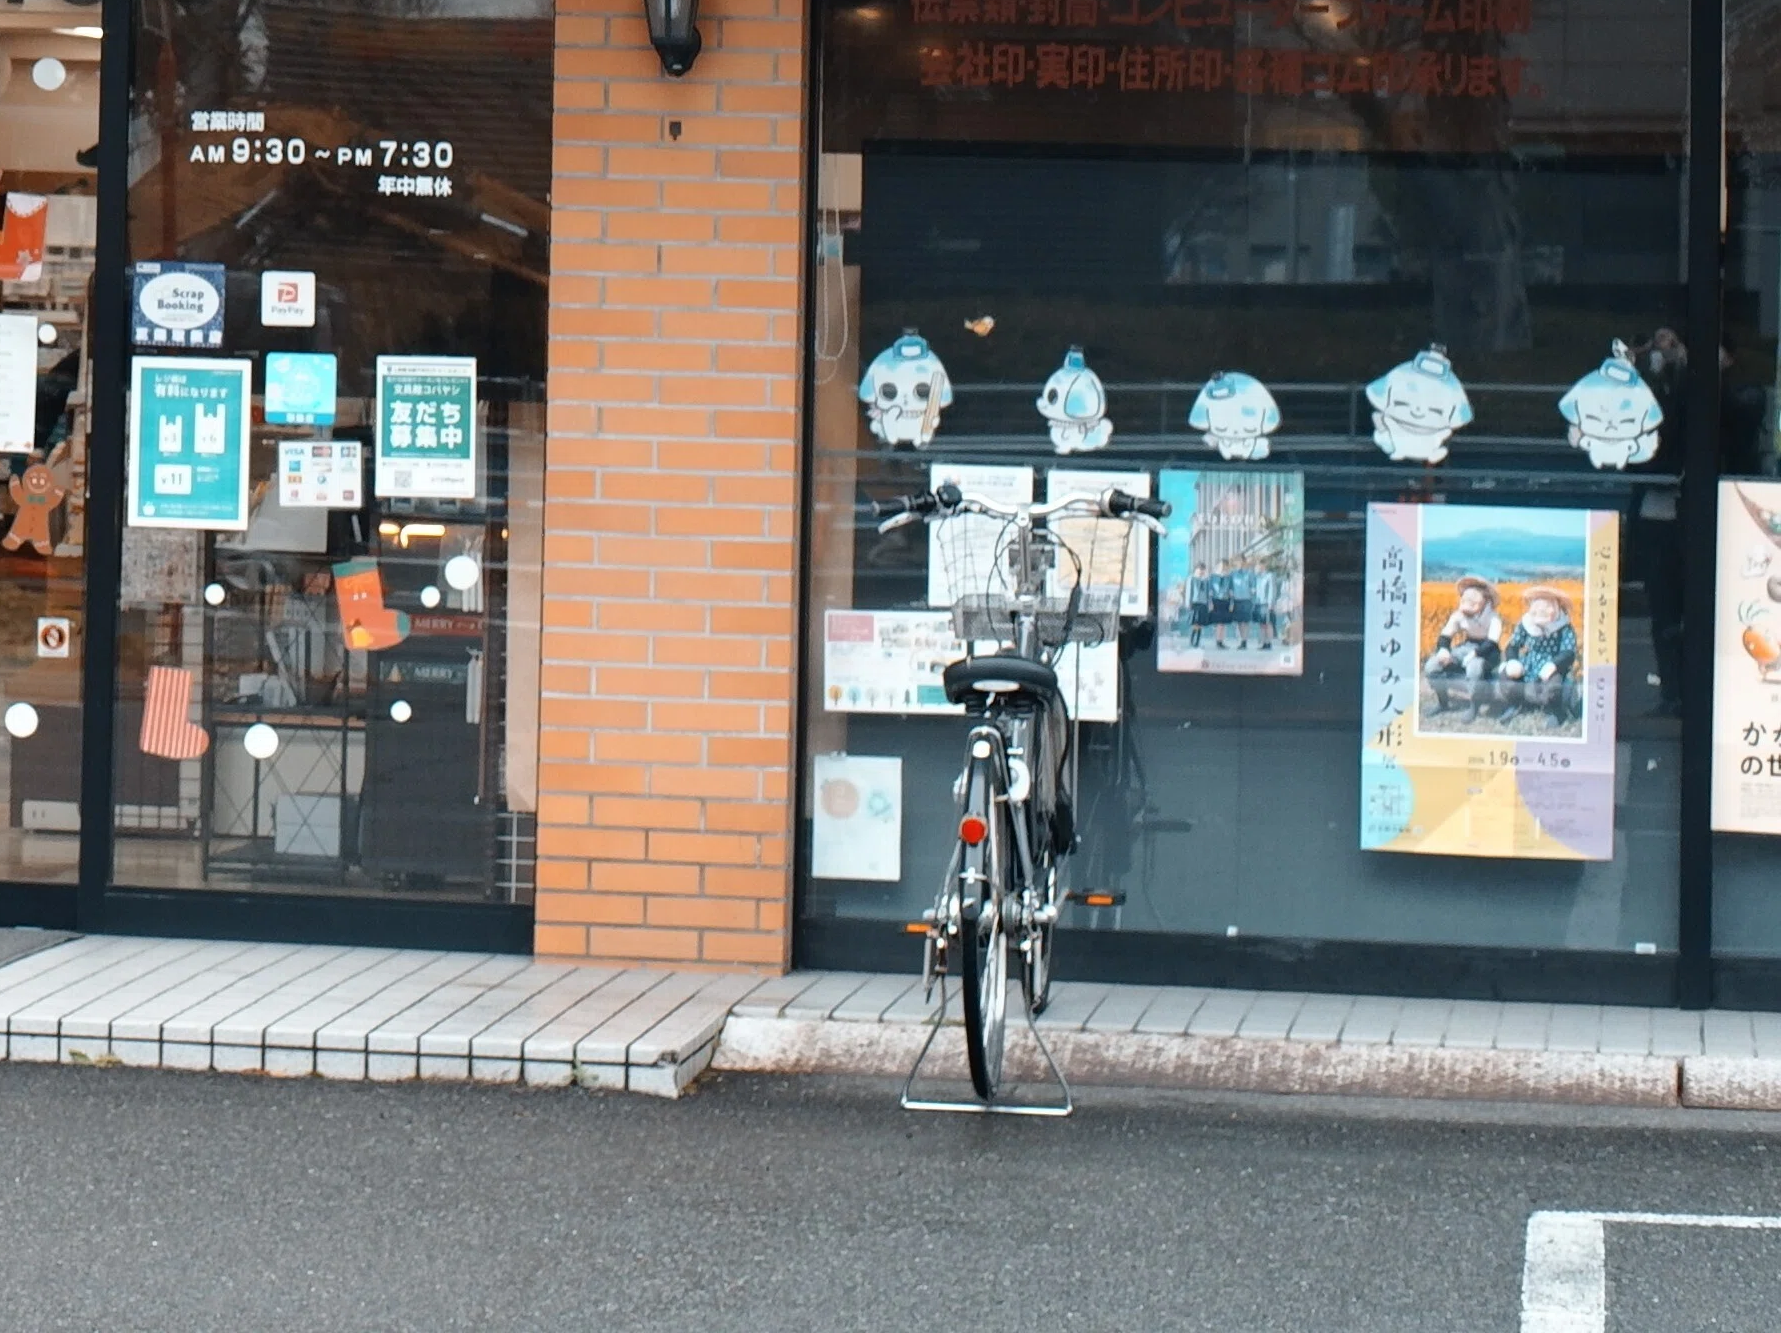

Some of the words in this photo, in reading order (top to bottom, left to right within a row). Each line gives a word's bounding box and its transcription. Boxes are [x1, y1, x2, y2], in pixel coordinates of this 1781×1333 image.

[191, 111, 265, 132] 営業時間
[190, 148, 225, 164] AM
[232, 137, 306, 165] 9:30
[338, 149, 372, 166] PM
[379, 141, 453, 168] 7:30
[378, 176, 453, 197] 年中無休
[172, 288, 204, 300] Scrap
[157, 299, 204, 313] Booking
[271, 305, 304, 316] PayPay
[390, 399, 462, 425] 友だち
[390, 424, 463, 450] 募集中
